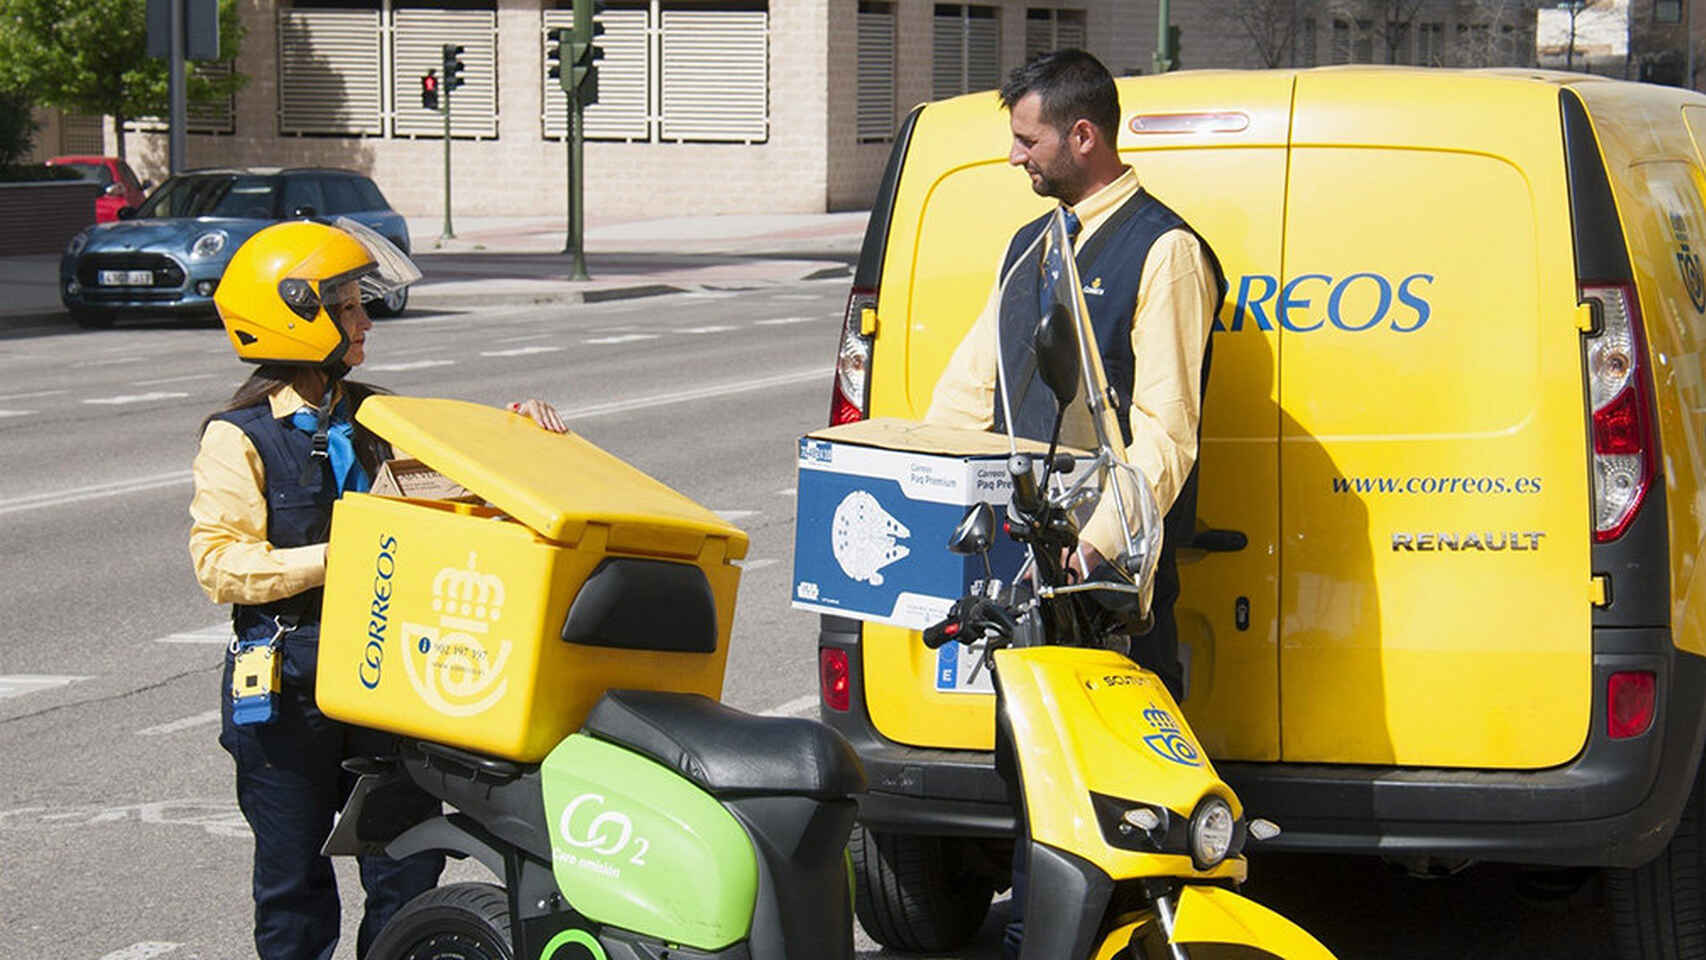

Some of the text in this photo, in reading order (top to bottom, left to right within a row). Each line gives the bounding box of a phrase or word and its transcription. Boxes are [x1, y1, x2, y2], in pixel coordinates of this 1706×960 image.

[1213, 272, 1434, 333] REOS
[977, 479, 1013, 491] Paq Pre
[1331, 476, 1542, 494] www.correos.es
[1391, 531, 1546, 552] RENAULT
[359, 534, 397, 689] CORREOS
[942, 669, 953, 682] E
